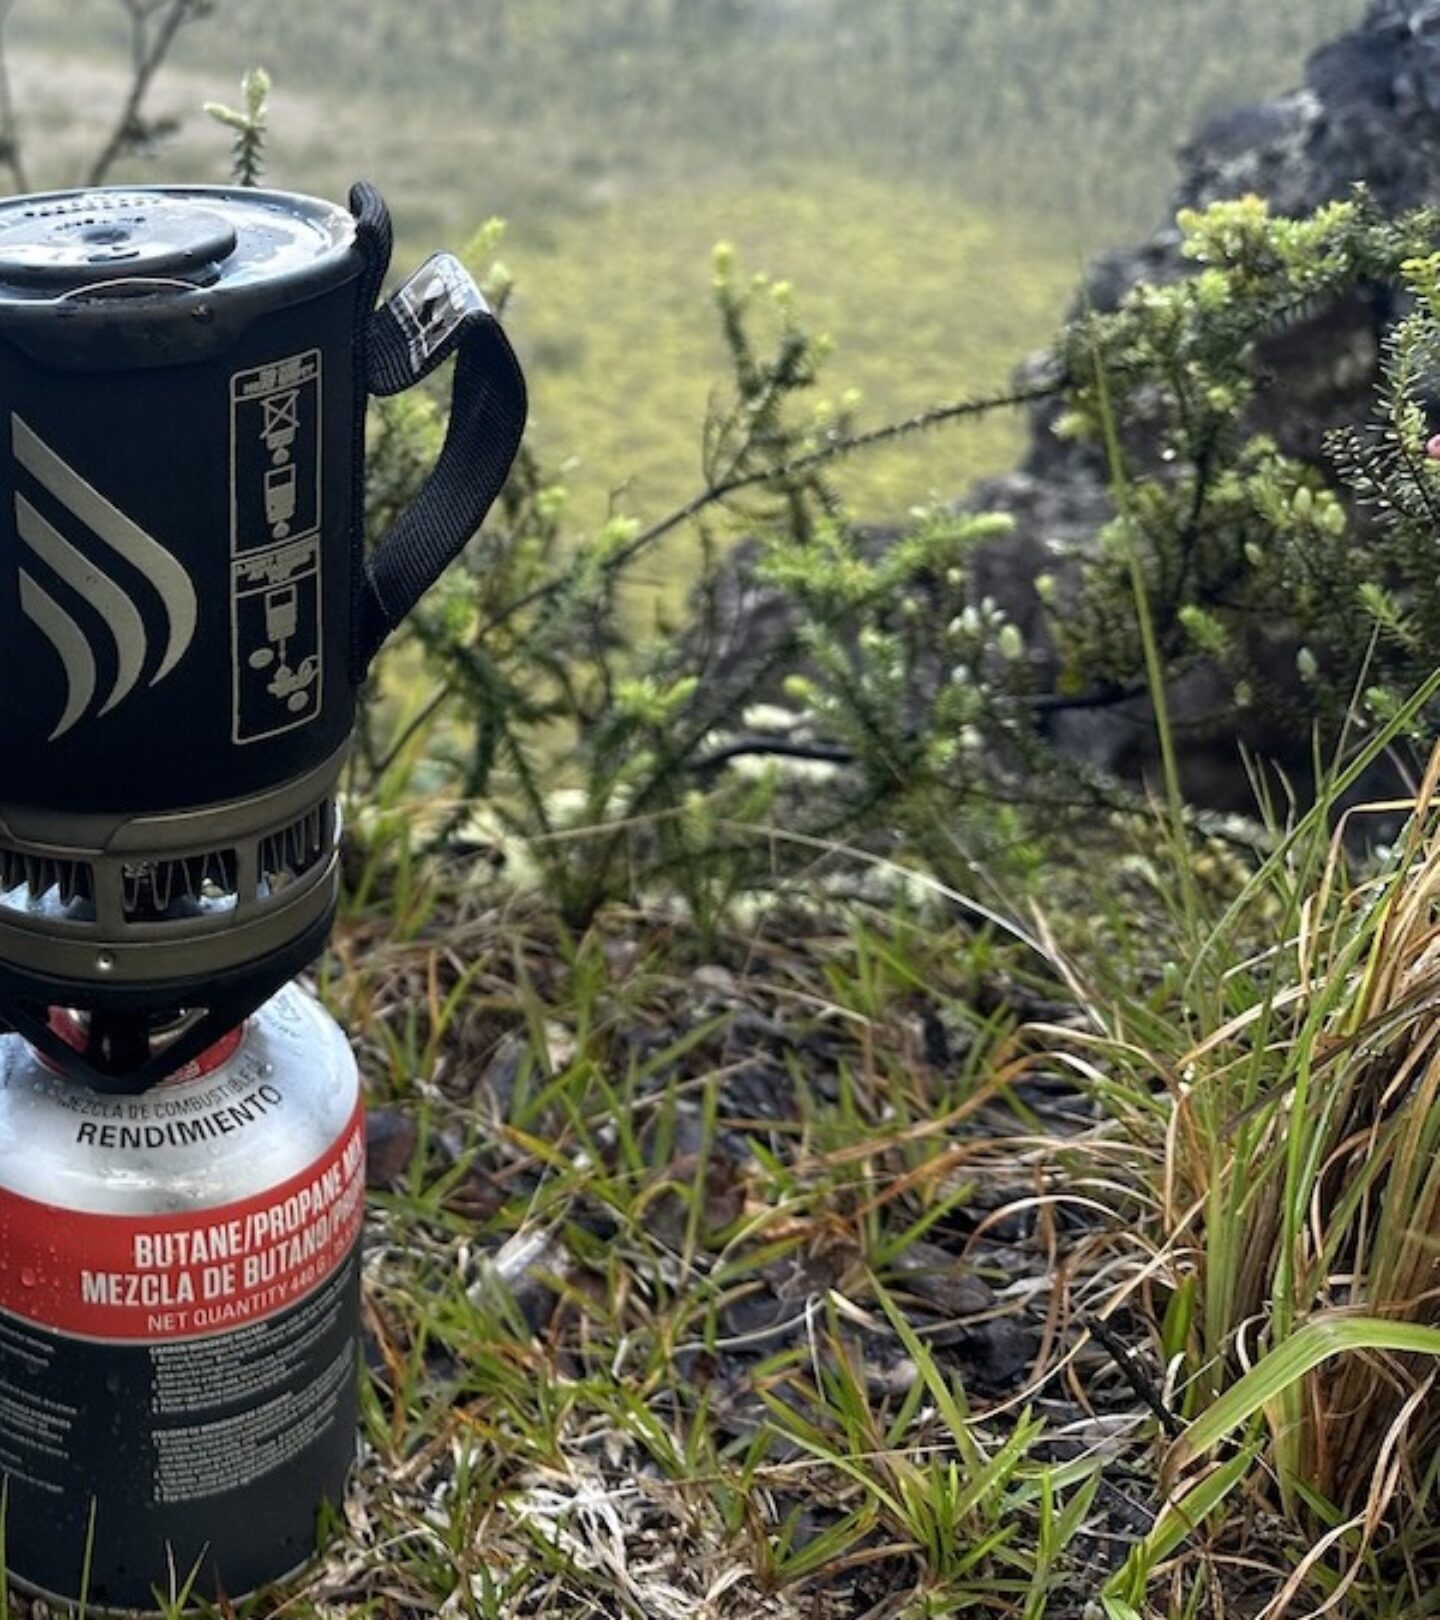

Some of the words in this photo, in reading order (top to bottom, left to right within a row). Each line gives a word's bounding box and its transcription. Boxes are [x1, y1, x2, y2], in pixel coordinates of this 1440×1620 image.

[76, 1084, 282, 1149] RENDIMIENTO
[128, 1103, 150, 1119] DE
[134, 1161, 342, 1268] BUTANE/PROPANE
[81, 1271, 195, 1306] MEZCLA
[203, 1263, 237, 1299] DE
[148, 1311, 189, 1331] NET
[193, 1281, 289, 1327] QUANTITY
